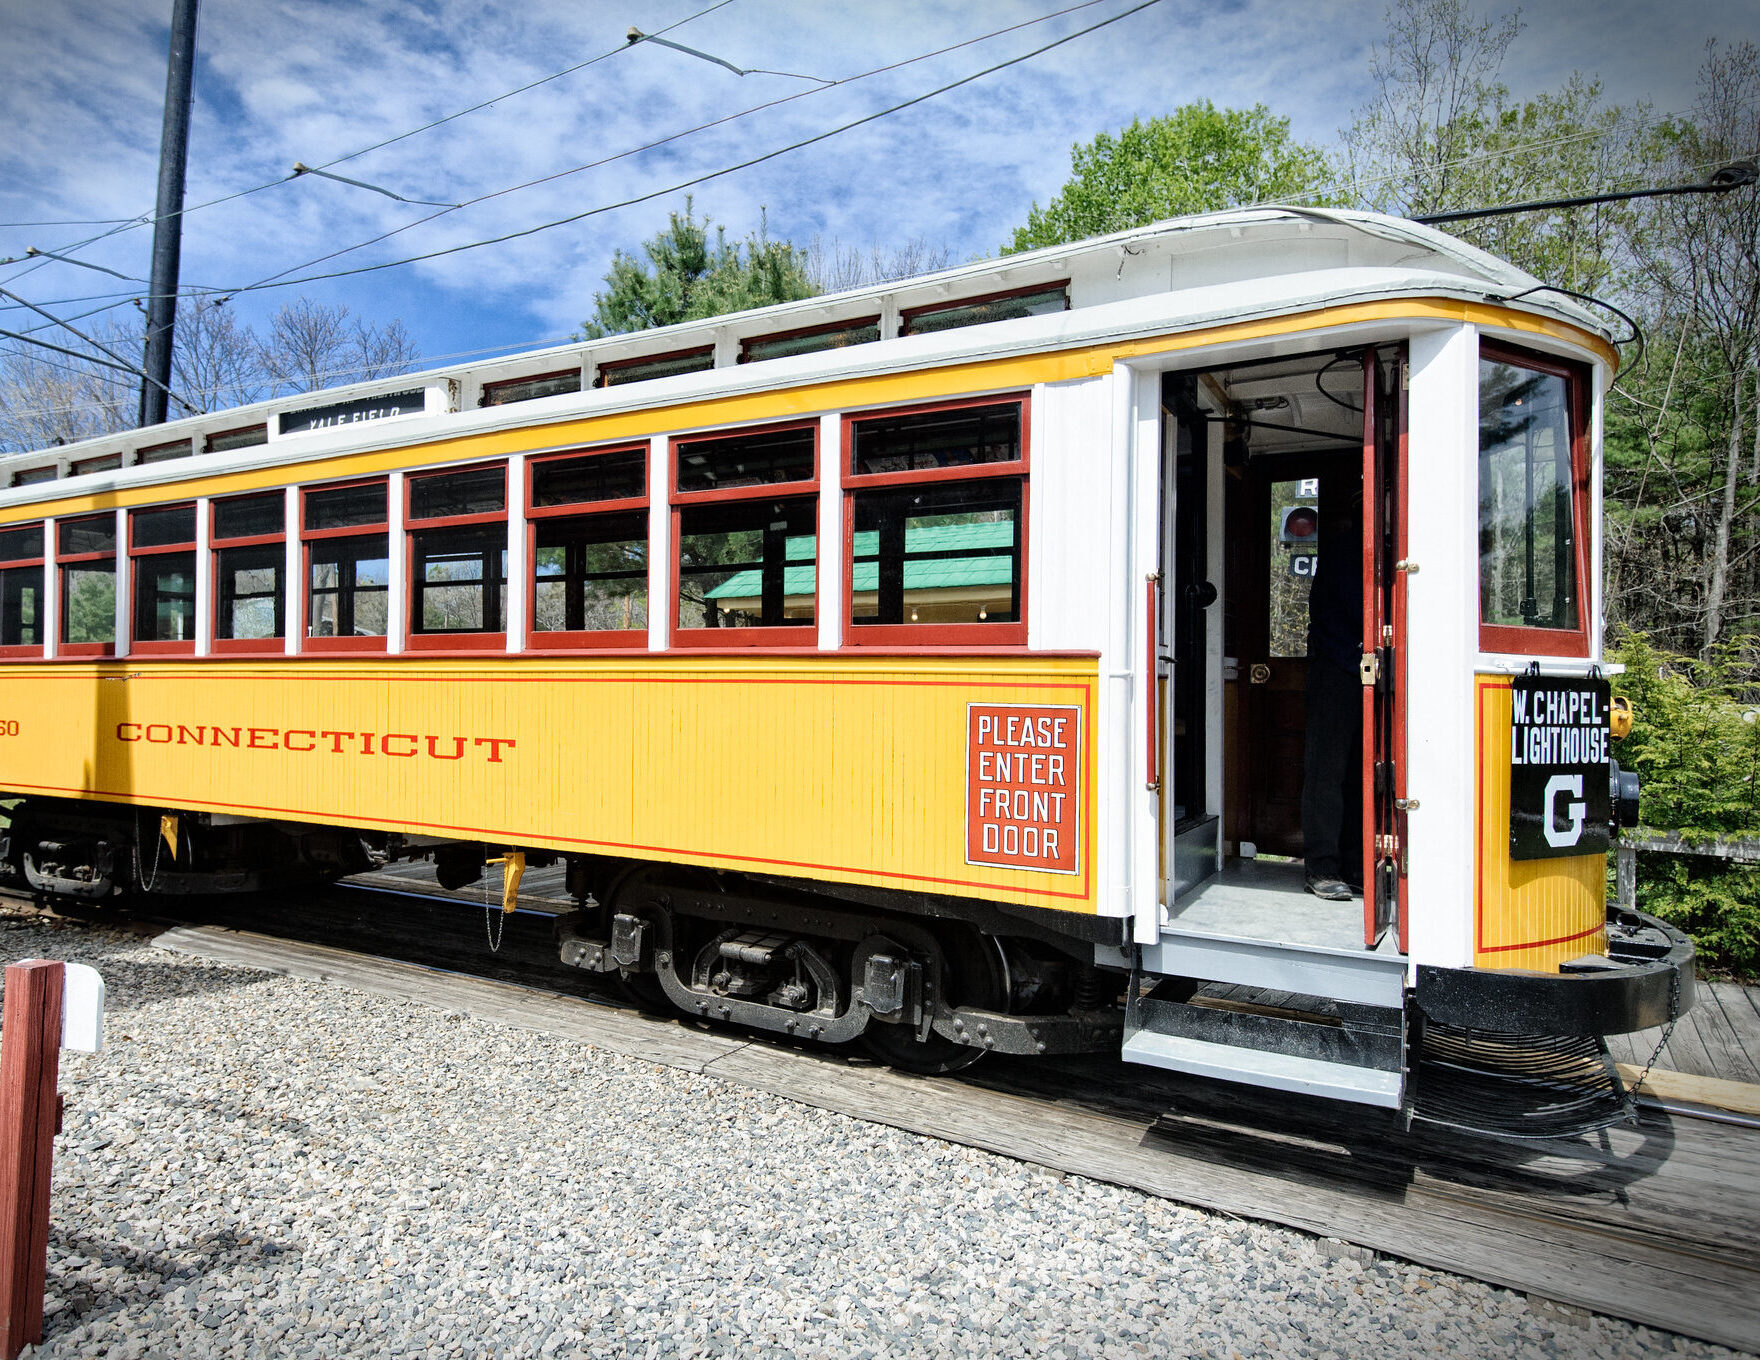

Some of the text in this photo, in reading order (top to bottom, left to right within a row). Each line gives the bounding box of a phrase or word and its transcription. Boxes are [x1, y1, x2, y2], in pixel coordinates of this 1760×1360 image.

[1512, 689, 1530, 725] W.
[116, 722, 516, 763] CONNECTICUT
[977, 715, 1068, 748] PLEASE
[1511, 726, 1610, 765] LIGHTHOUSE
[978, 751, 1066, 786] ENTER
[979, 787, 1067, 824] FRONT
[1543, 774, 1586, 848] G
[982, 823, 1060, 860] DOOR
